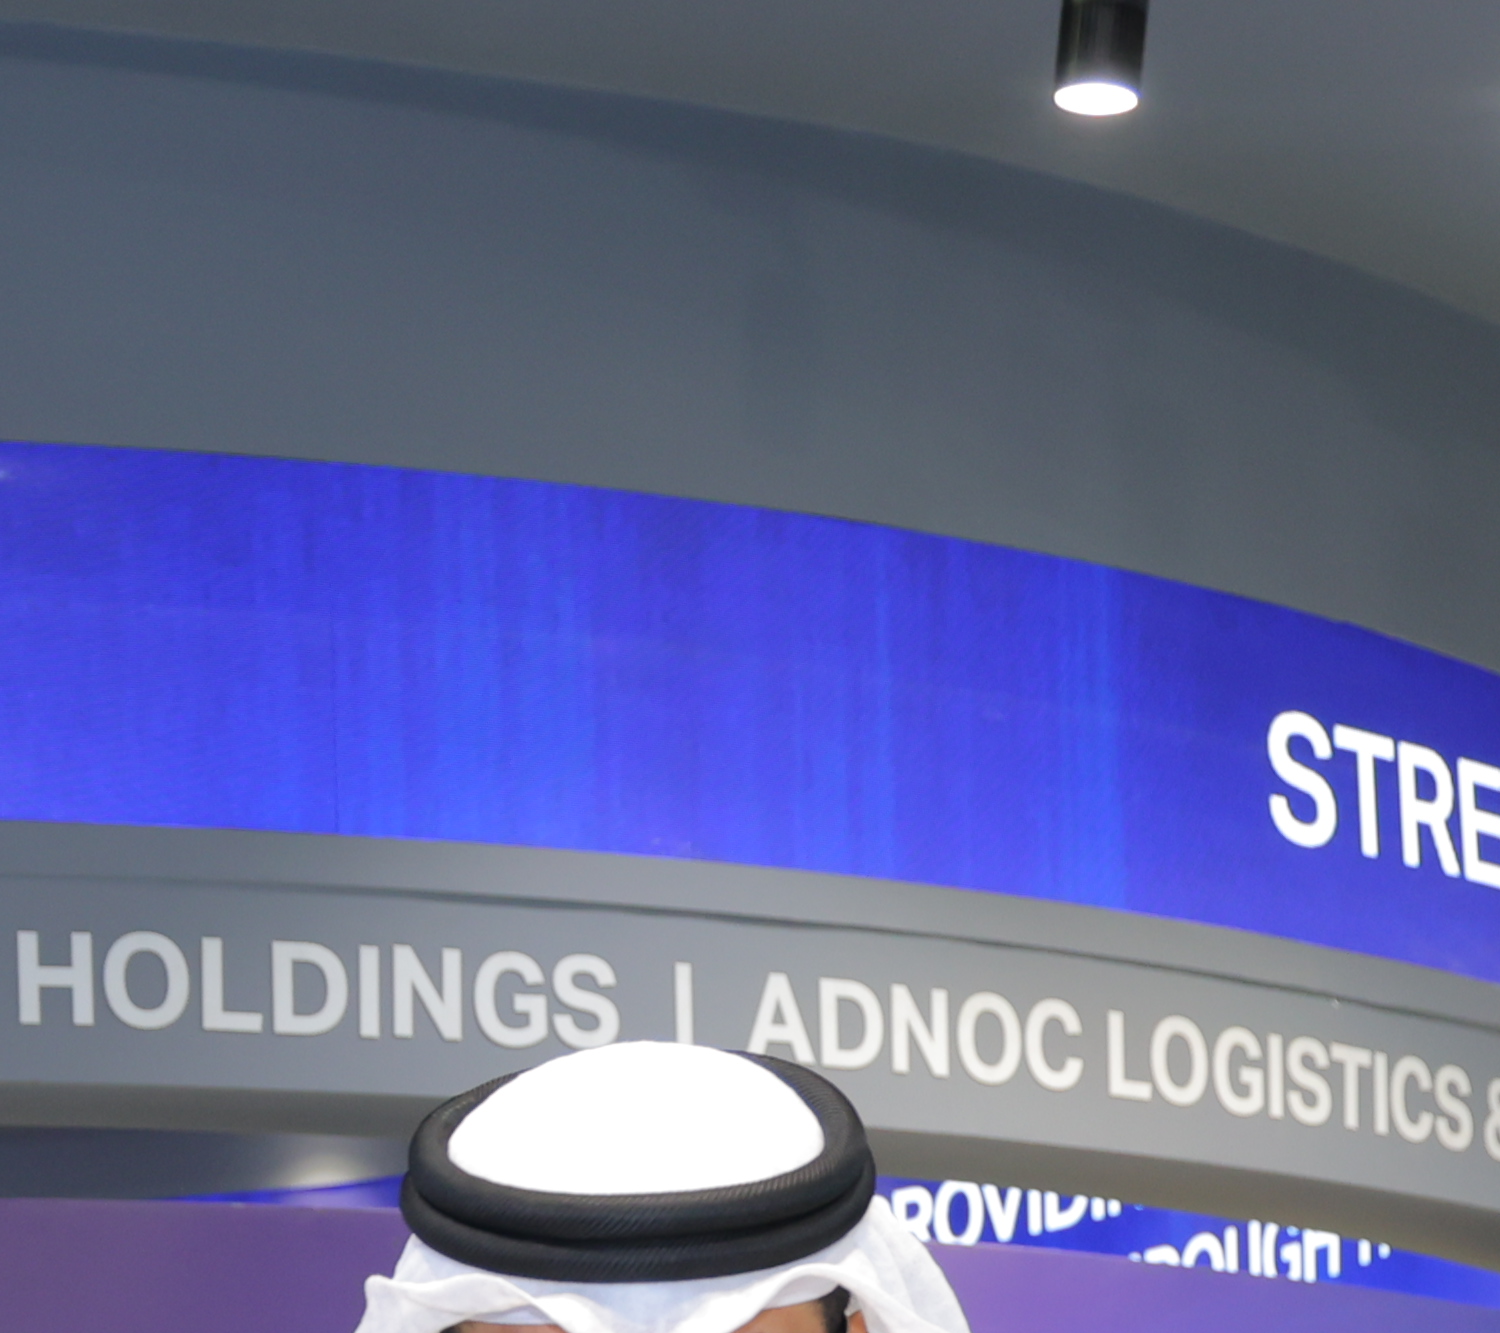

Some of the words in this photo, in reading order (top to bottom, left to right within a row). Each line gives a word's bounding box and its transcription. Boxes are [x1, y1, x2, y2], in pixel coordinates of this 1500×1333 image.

[15, 929, 621, 1049] HOLDINGS
[746, 973, 1085, 1093] ADNOC
[1106, 1008, 1476, 1152] LOGISTICS
